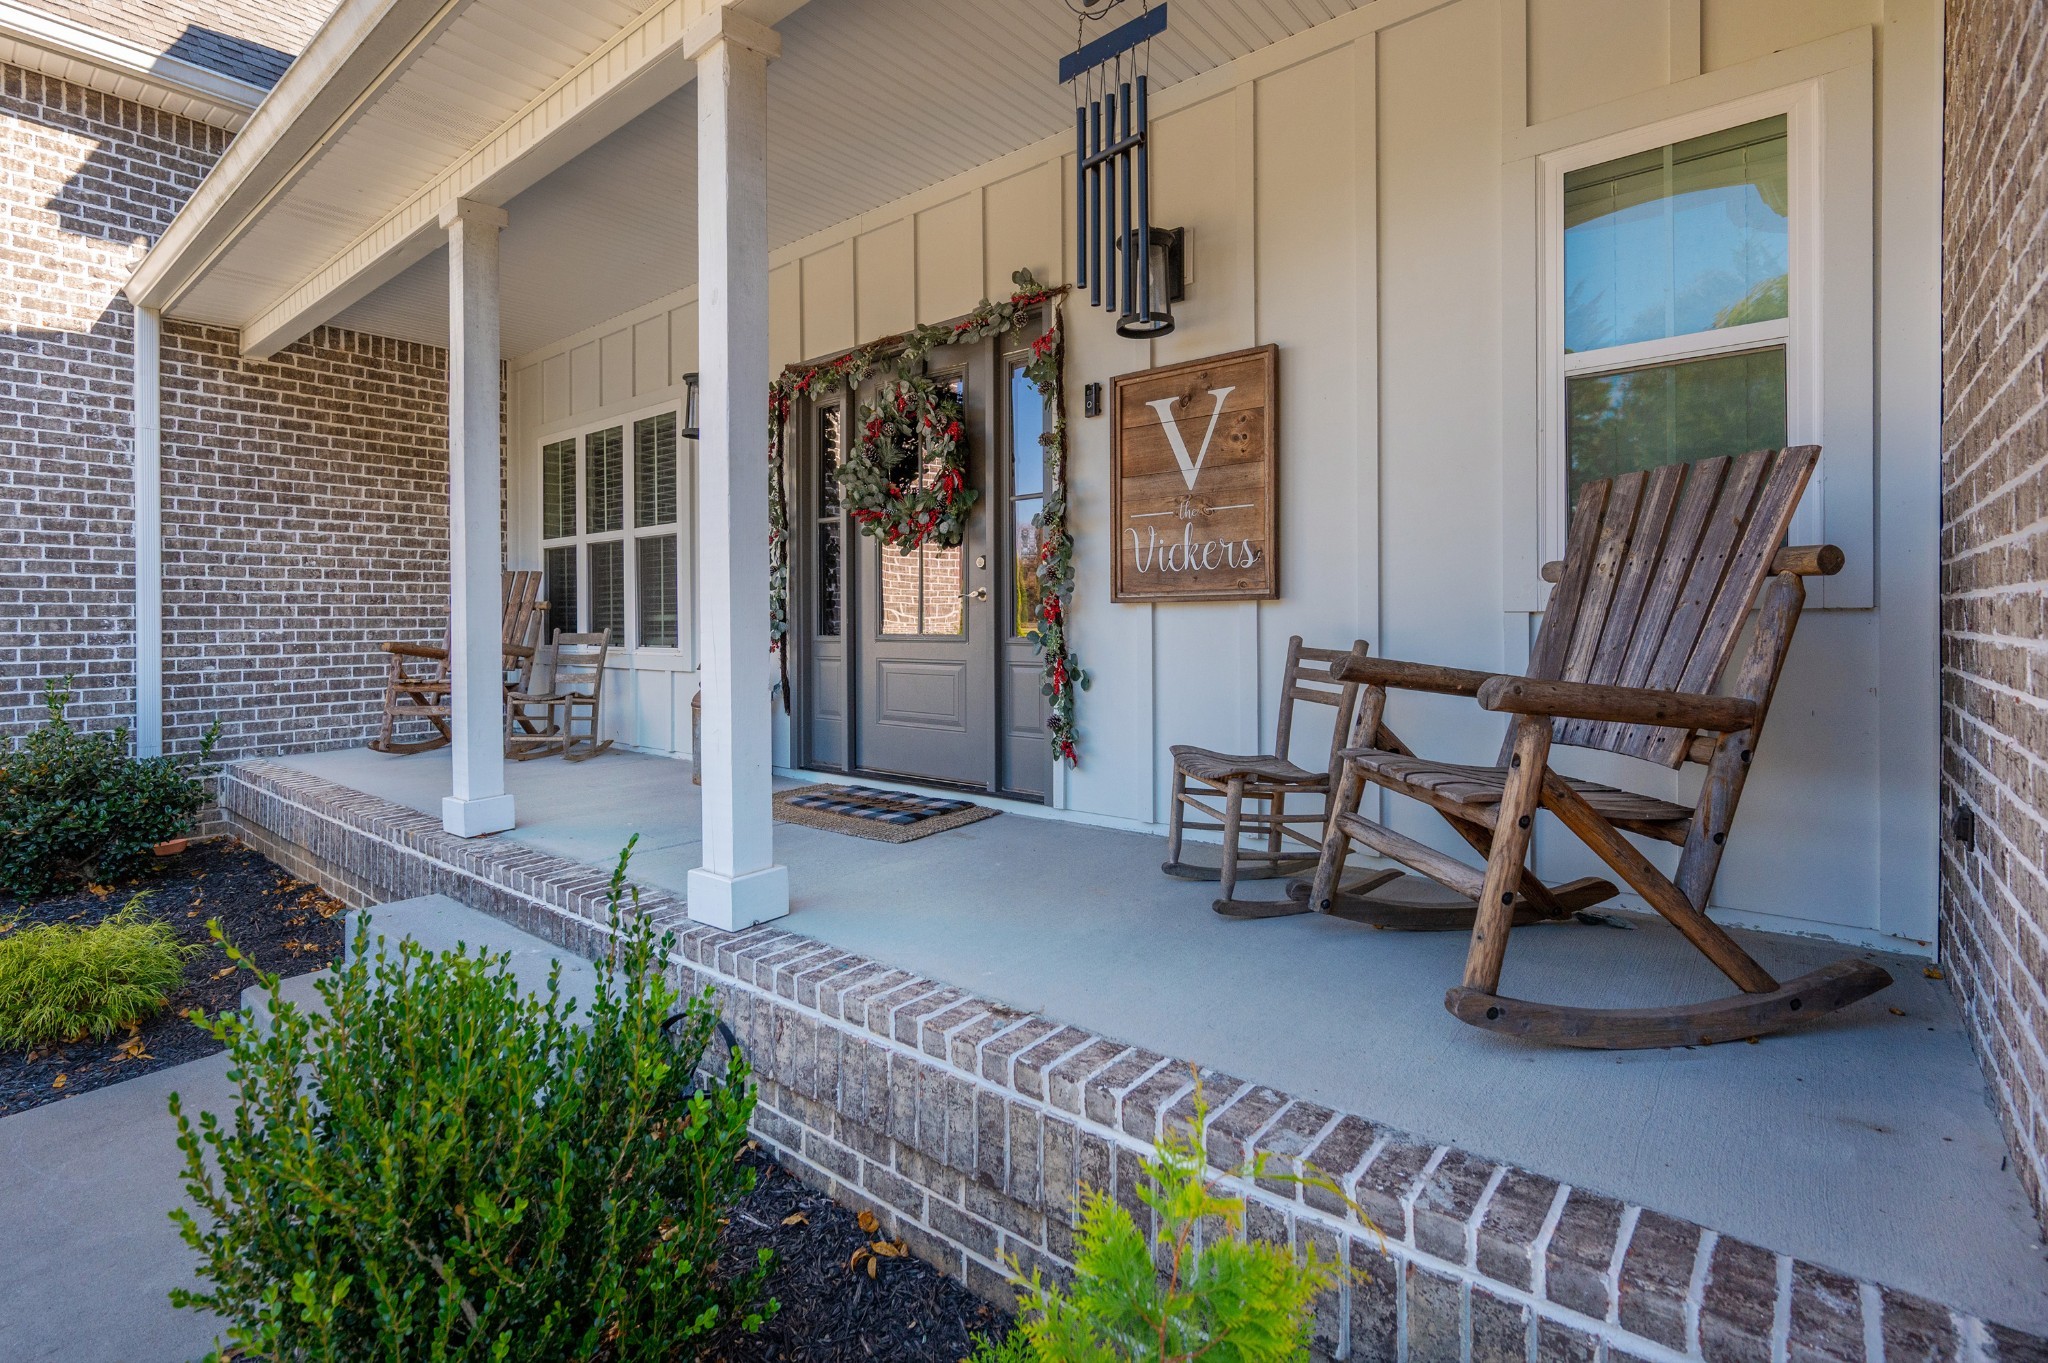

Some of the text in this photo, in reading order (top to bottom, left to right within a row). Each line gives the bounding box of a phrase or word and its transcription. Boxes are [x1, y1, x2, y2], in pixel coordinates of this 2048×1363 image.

[1146, 386, 1235, 490] V
[1178, 501, 1198, 520] the
[1125, 522, 1261, 573] Vickers
